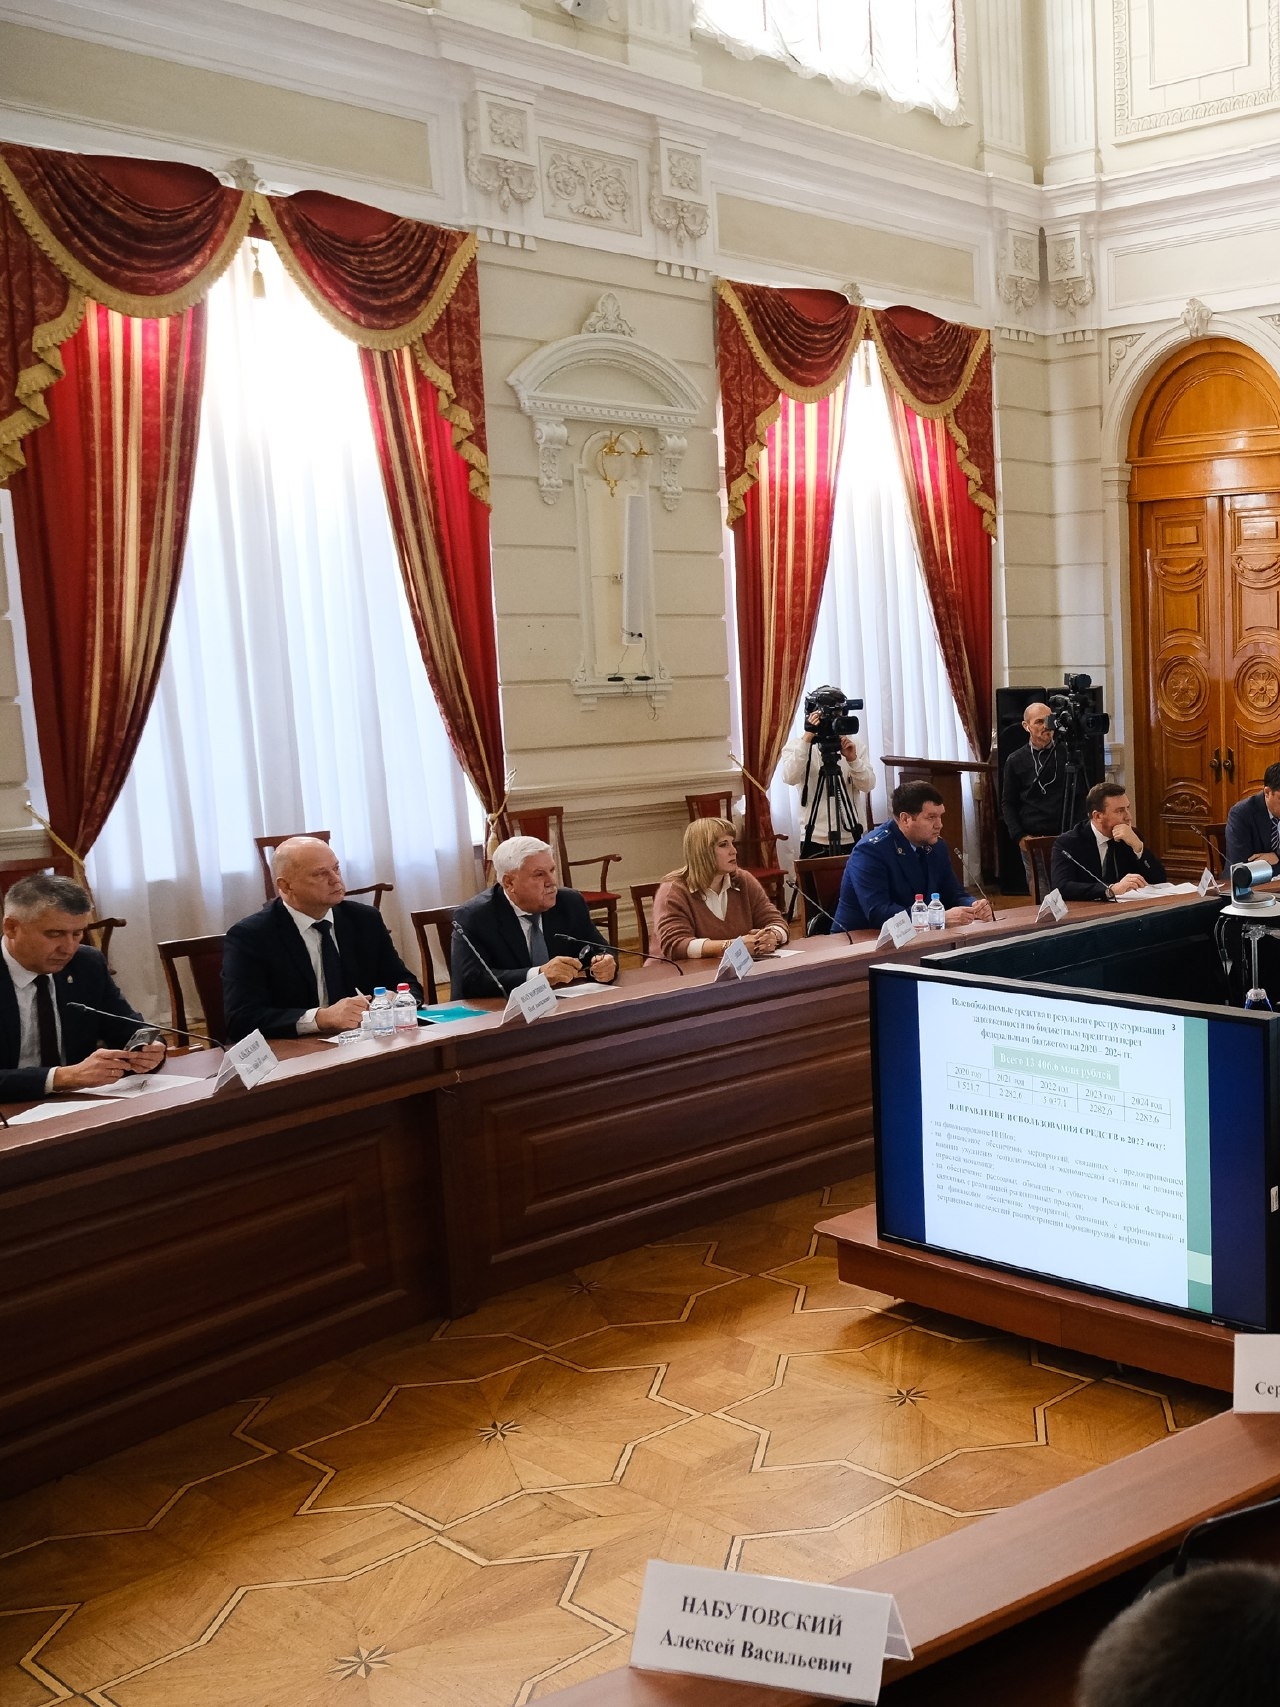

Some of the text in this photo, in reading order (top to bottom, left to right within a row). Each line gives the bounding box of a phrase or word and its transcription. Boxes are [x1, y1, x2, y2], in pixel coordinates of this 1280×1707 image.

[1080, 1043, 1097, 1053] 2020
[954, 1066, 969, 1076] 2020
[999, 1052, 1024, 1065] Всего
[1080, 1066, 1112, 1082] рублей
[996, 1073, 1011, 1083] 2021
[1039, 1080, 1056, 1091] 2022
[1085, 1088, 1102, 1099] 2023
[1130, 1096, 1148, 1107] 2024
[681, 1595, 844, 1637] НАБУТОВСКИЙ
[659, 1627, 853, 1675] Алексей Васильевич
